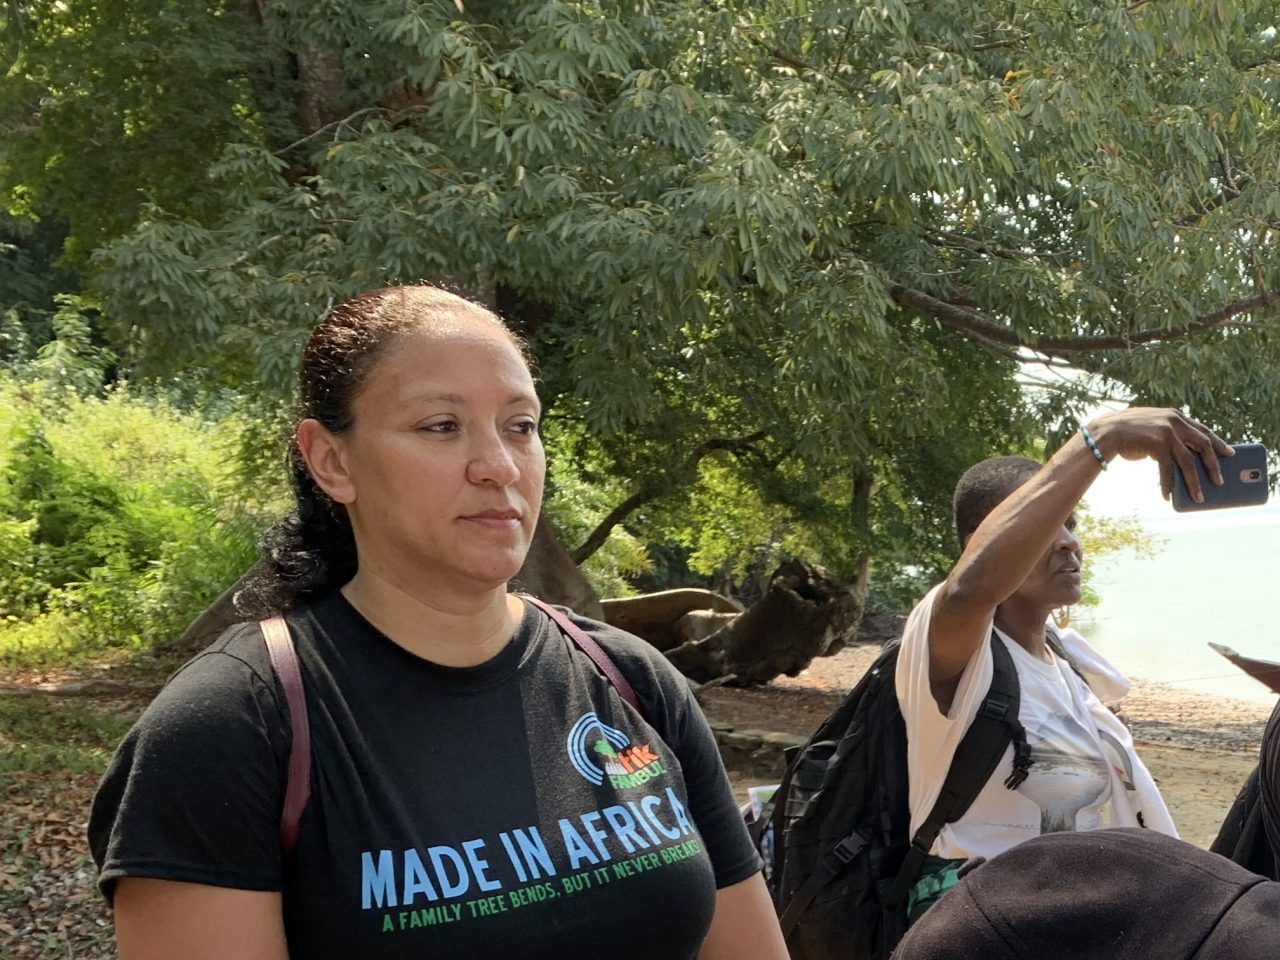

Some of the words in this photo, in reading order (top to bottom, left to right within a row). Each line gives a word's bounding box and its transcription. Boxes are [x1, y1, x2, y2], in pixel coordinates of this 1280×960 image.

[361, 838, 502, 910] MADE
[499, 826, 556, 883] IN
[558, 787, 696, 870] AFRICA
[382, 915, 395, 933] A
[399, 903, 462, 931] FAMILY
[466, 895, 506, 919] TREE
[510, 882, 562, 910] BENDS,
[562, 871, 591, 894] BUT
[595, 866, 611, 886] IT
[612, 853, 662, 880] NEVER
